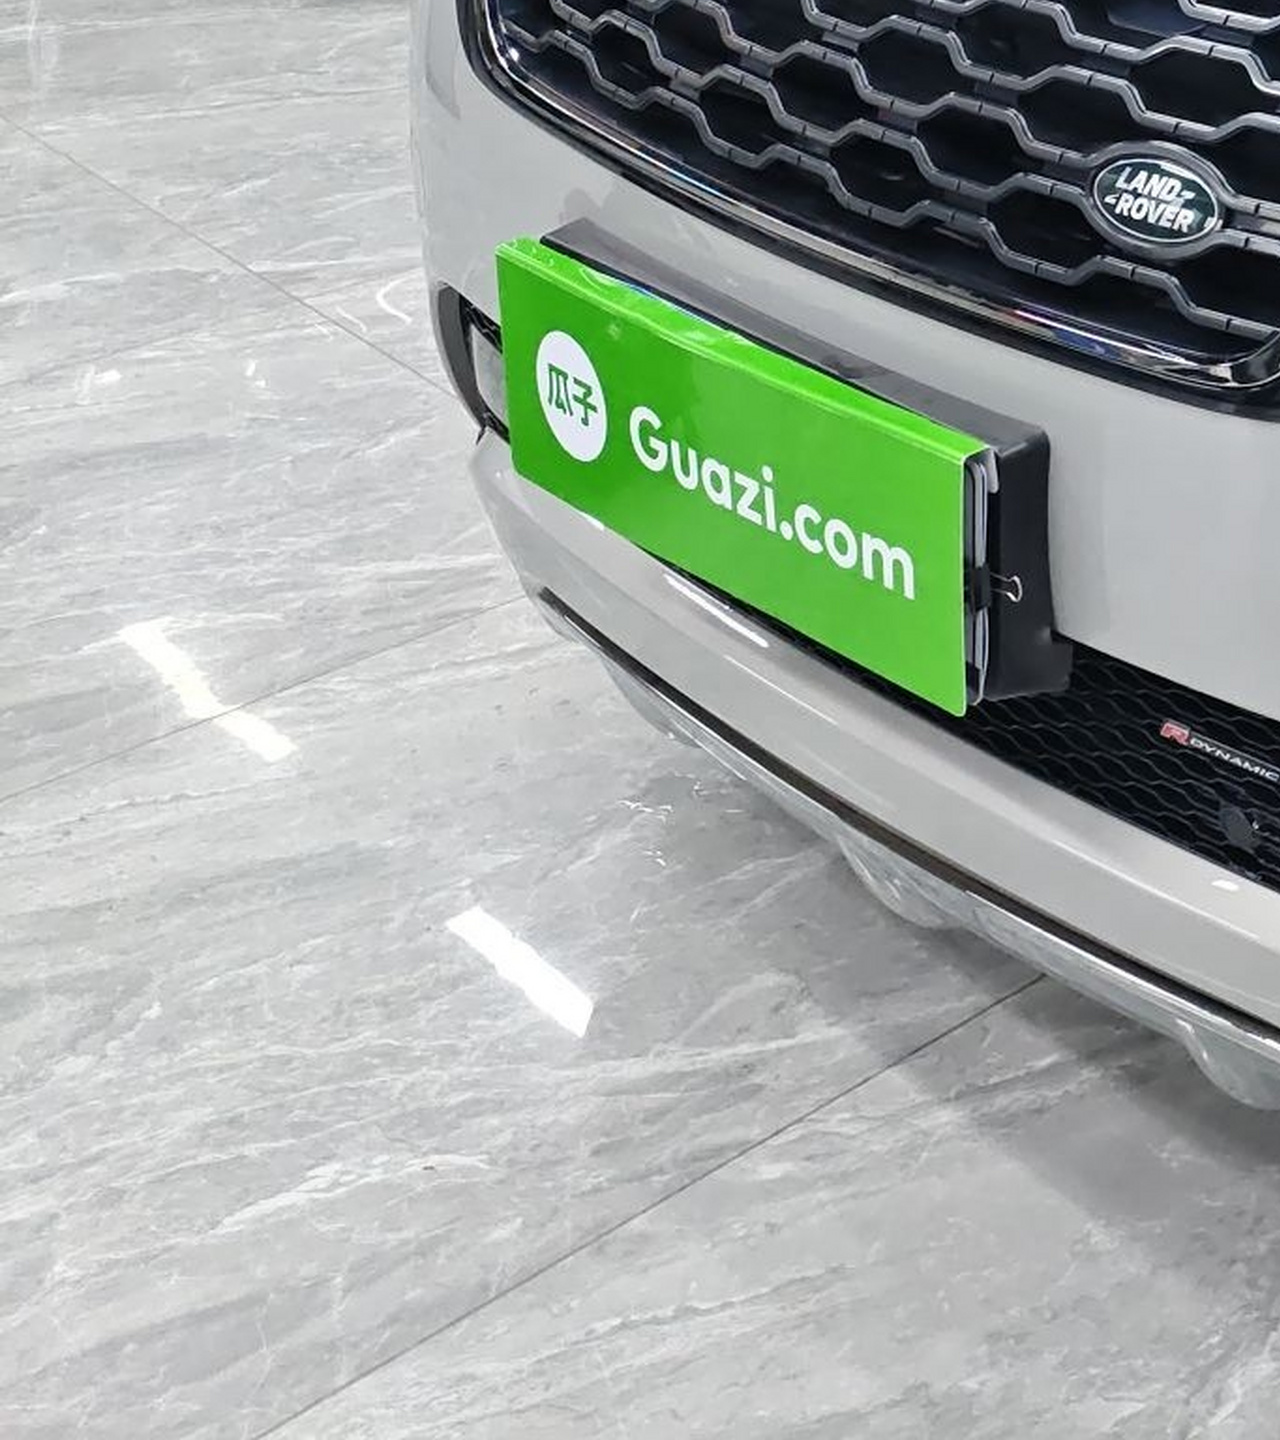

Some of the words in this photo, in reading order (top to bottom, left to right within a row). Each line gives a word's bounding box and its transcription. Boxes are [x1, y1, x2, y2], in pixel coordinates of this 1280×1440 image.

[1115, 166, 1183, 202] LAND
[1113, 192, 1195, 233] ROVER
[547, 362, 599, 427] 瓜子
[629, 406, 915, 601] Guazi.com
